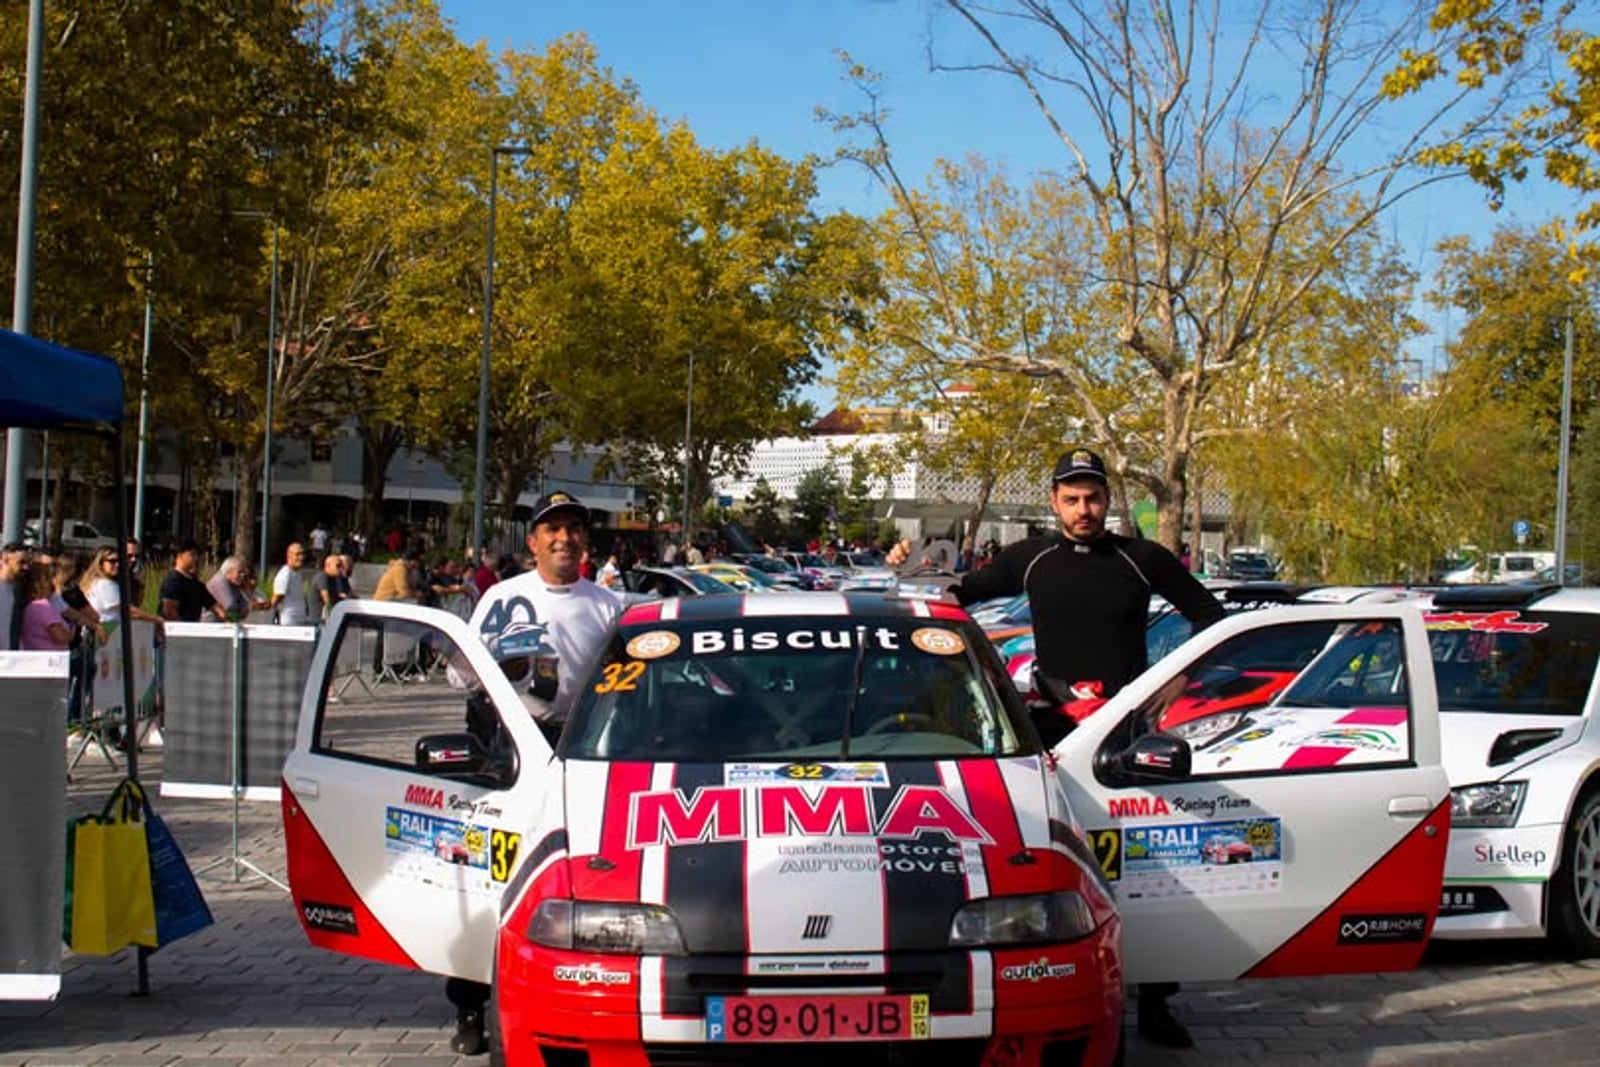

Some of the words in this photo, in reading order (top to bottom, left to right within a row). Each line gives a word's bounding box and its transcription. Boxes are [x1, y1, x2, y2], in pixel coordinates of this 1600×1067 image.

[480, 595, 538, 634] 40
[692, 626, 899, 655] Biscuit
[595, 661, 647, 694] 32
[788, 765, 824, 779] 32
[405, 784, 444, 810] MMA
[1109, 796, 1169, 818] MMA
[1171, 796, 1217, 817] Racing
[401, 813, 433, 836] RALI
[625, 785, 997, 851] MMA
[1149, 826, 1199, 848] RALI
[1475, 844, 1546, 866] Stellep
[913, 1000, 926, 1014] 97
[711, 1024, 722, 1038] P
[914, 1022, 926, 1035] 10
